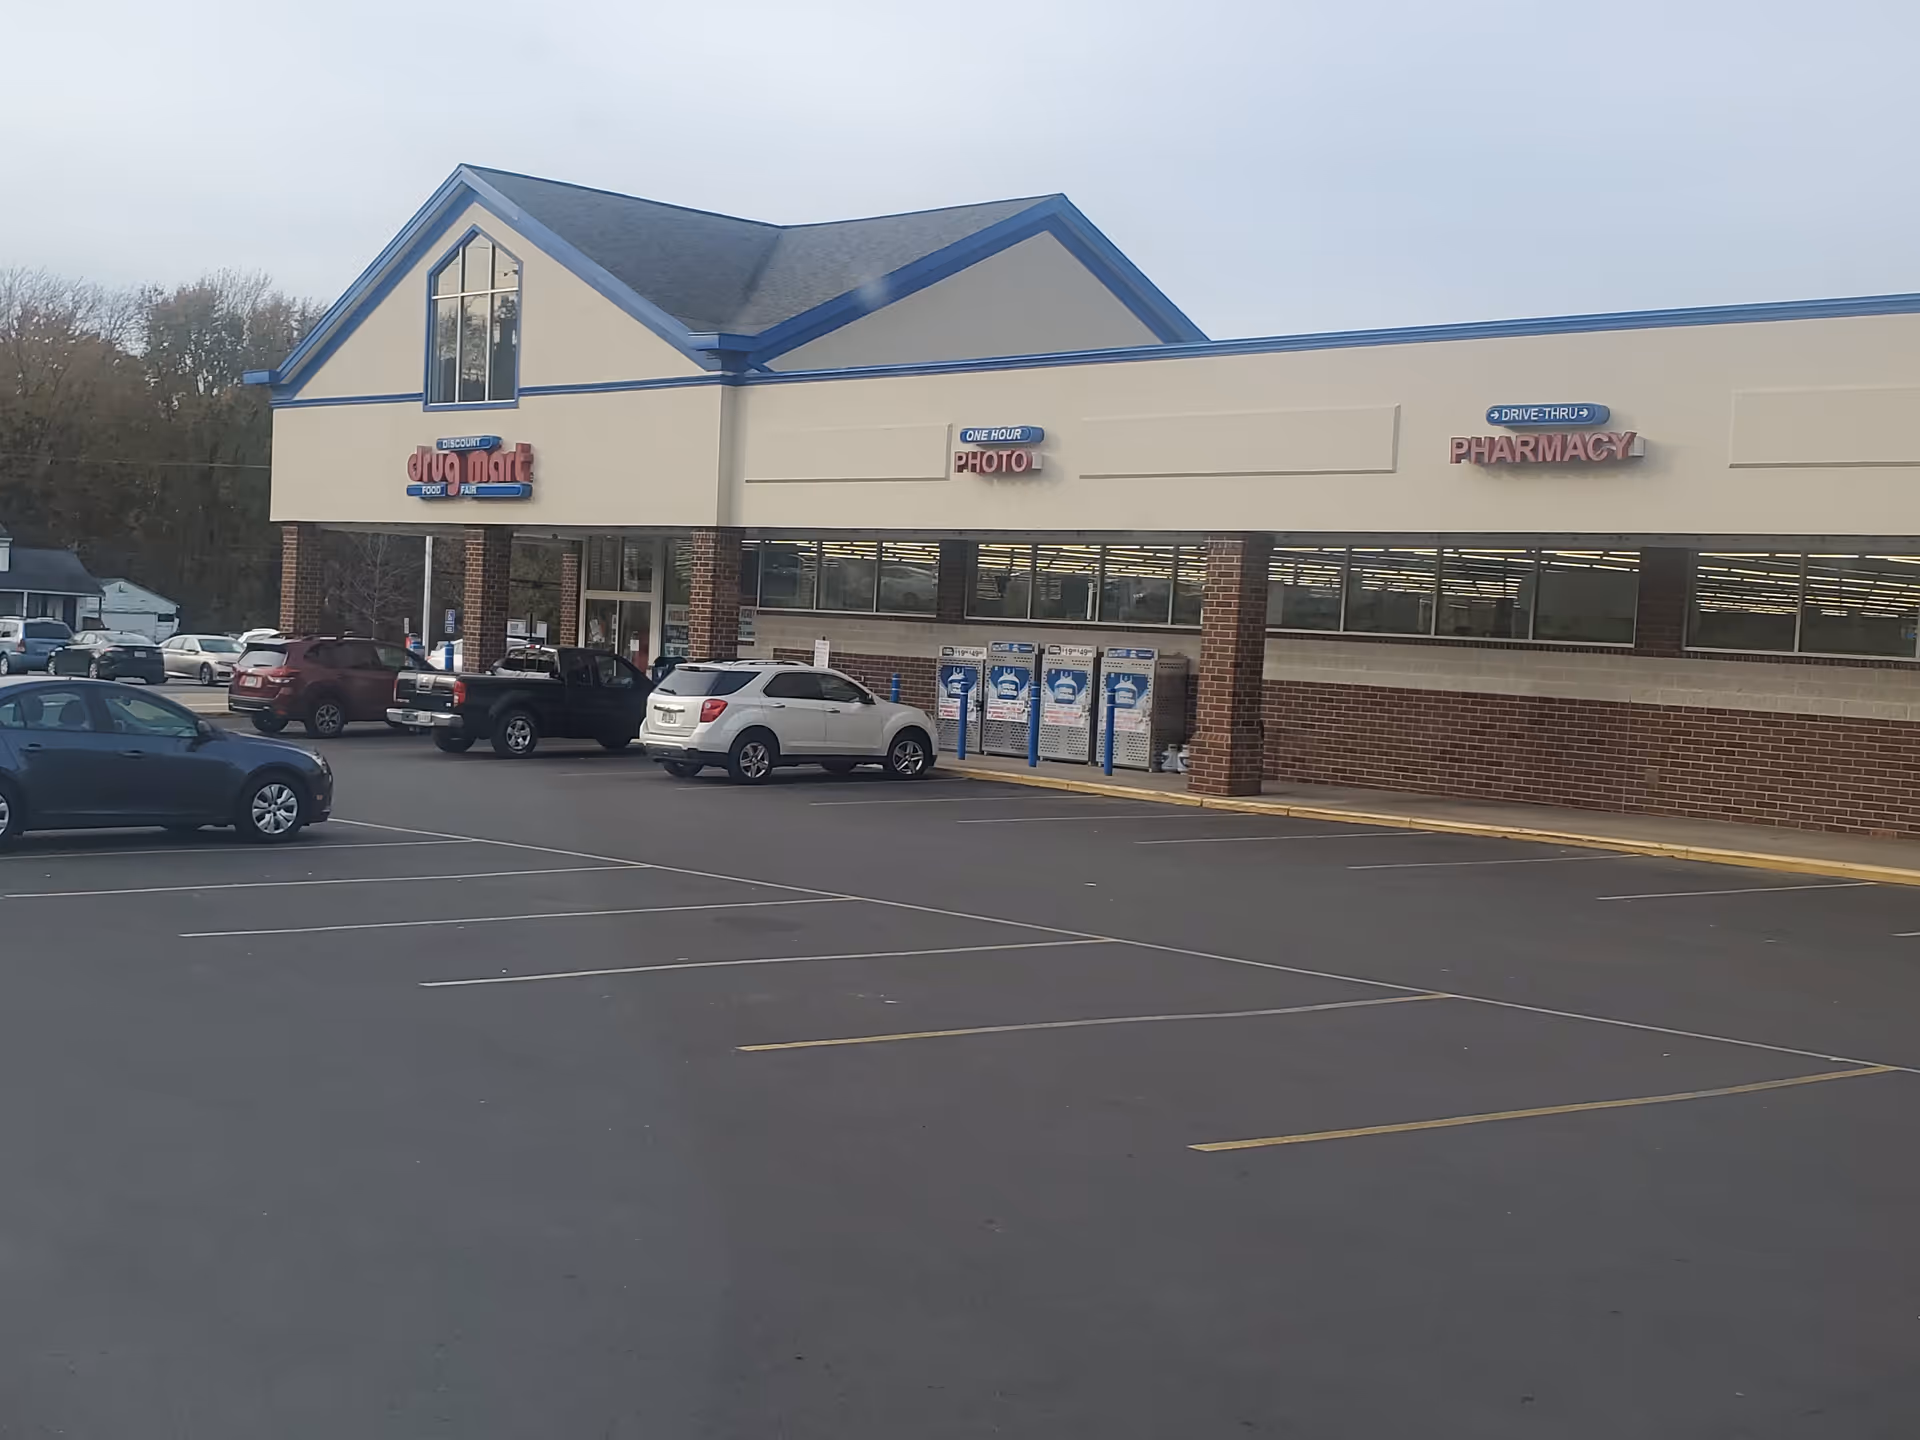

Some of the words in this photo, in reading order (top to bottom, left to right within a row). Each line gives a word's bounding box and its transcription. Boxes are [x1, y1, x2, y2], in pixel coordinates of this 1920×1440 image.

[1501, 407, 1578, 421] DRIVE-THRU
[966, 430, 989, 441] ONE
[990, 428, 1022, 440] HOUR
[442, 437, 480, 449] DISCOUNT
[1450, 431, 1637, 464] PHARMACY
[954, 450, 1029, 473] PHOTO
[407, 444, 460, 496] drug
[466, 442, 534, 483] mart
[421, 485, 441, 495] FOOD
[460, 485, 477, 495] FAIR
